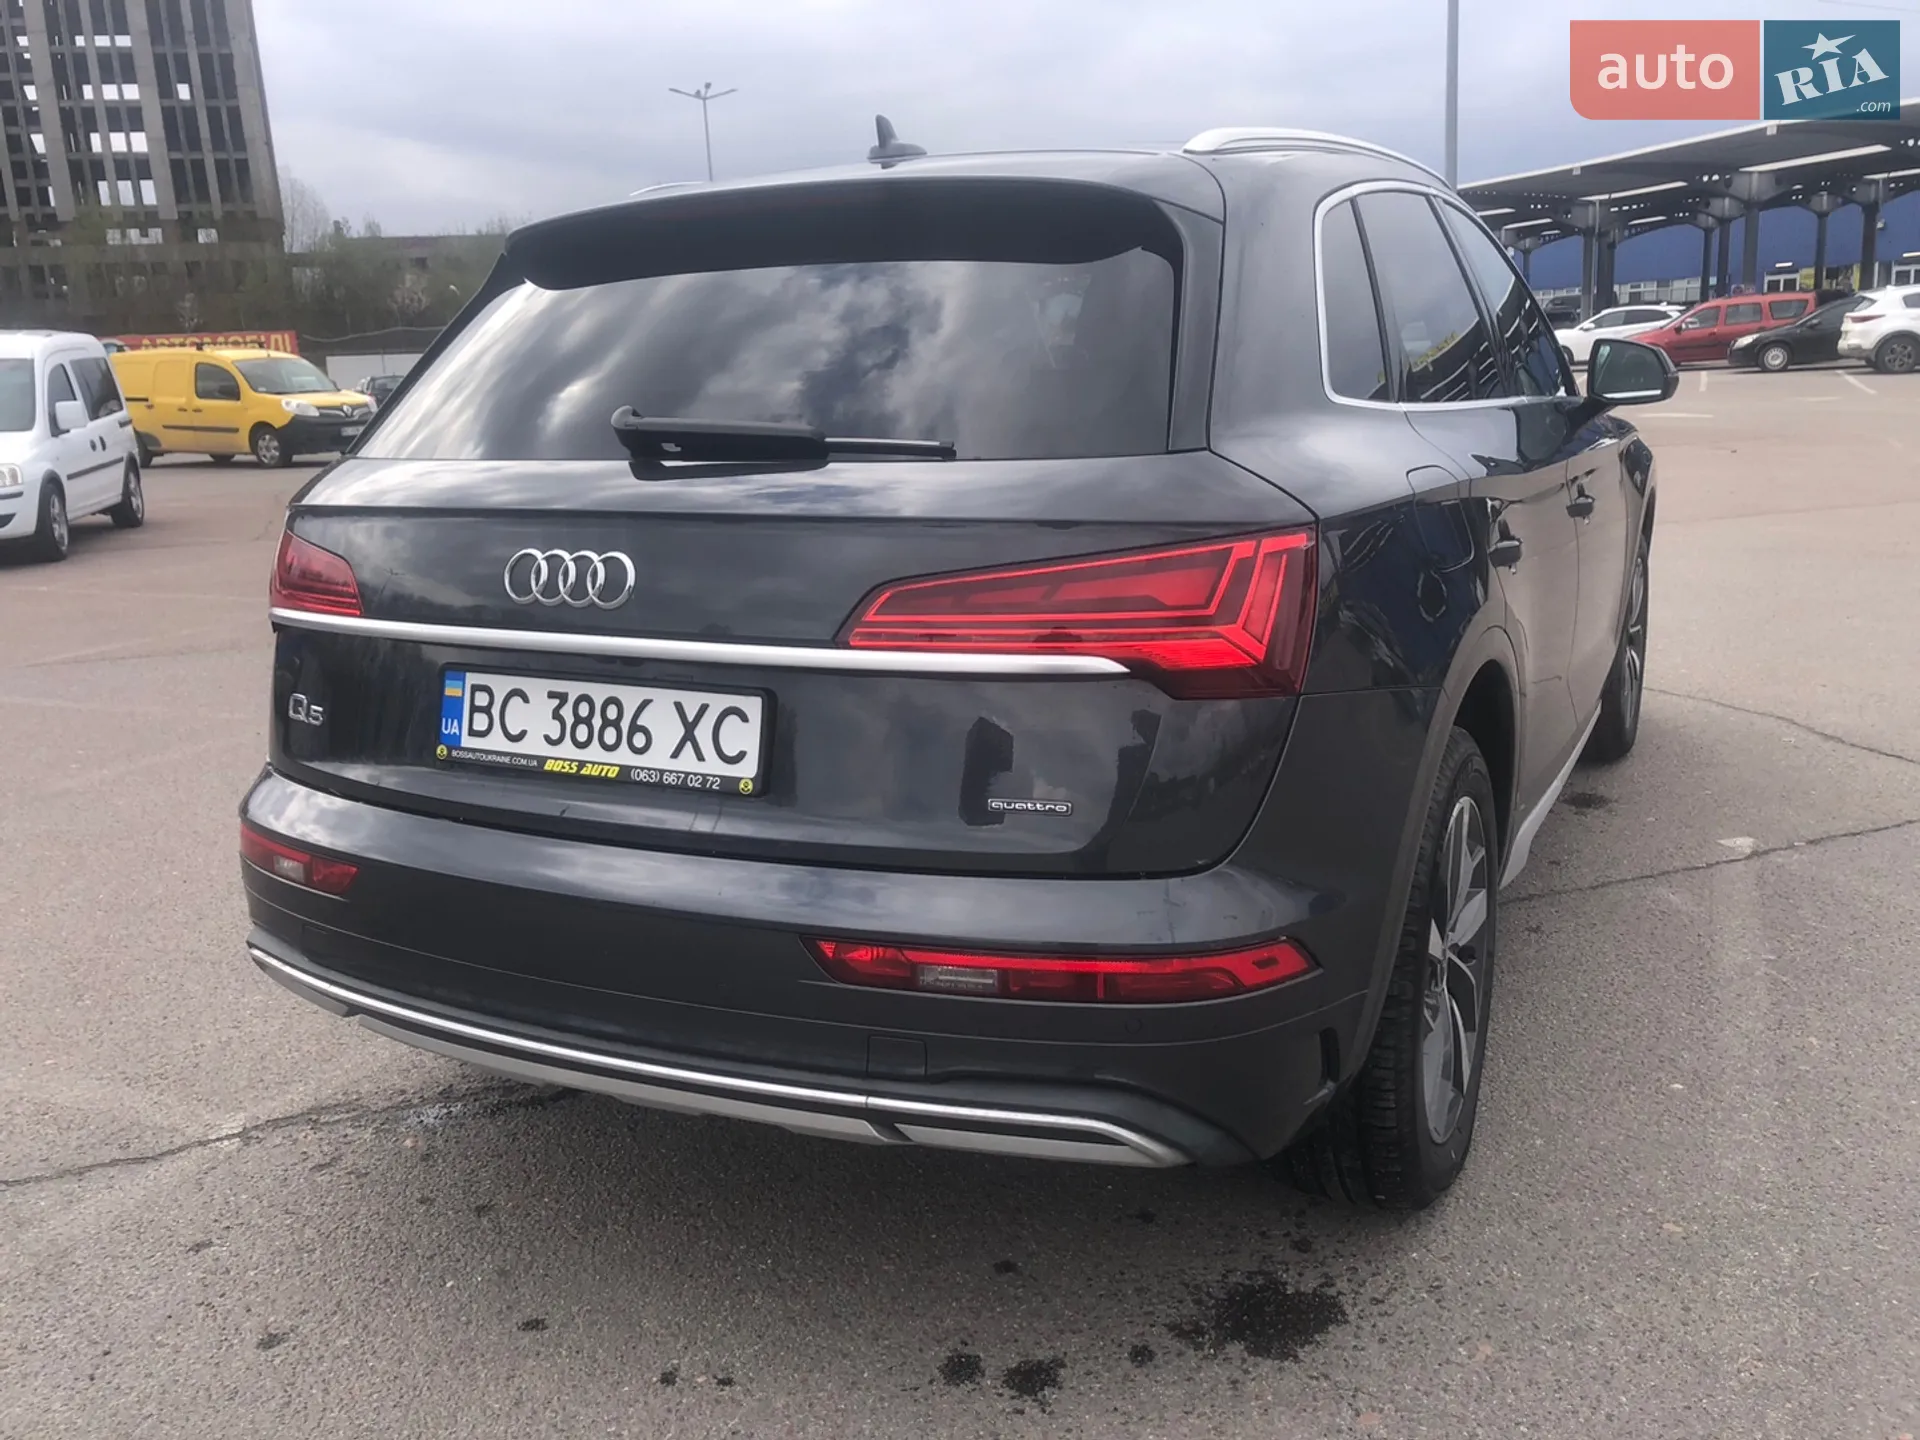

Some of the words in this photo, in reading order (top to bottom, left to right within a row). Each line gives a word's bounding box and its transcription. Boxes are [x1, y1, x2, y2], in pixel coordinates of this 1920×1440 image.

[288, 693, 324, 726] Q5
[441, 718, 460, 736] UA
[467, 683, 531, 743] BC
[543, 690, 654, 755] 3886
[669, 701, 750, 765] XC
[543, 758, 579, 774] BOSS
[580, 763, 620, 779] AUTO
[630, 767, 660, 783] (063)
[663, 773, 684, 786] 667
[687, 775, 702, 788] 02
[705, 776, 721, 790] 72
[991, 801, 1067, 812] quattro
